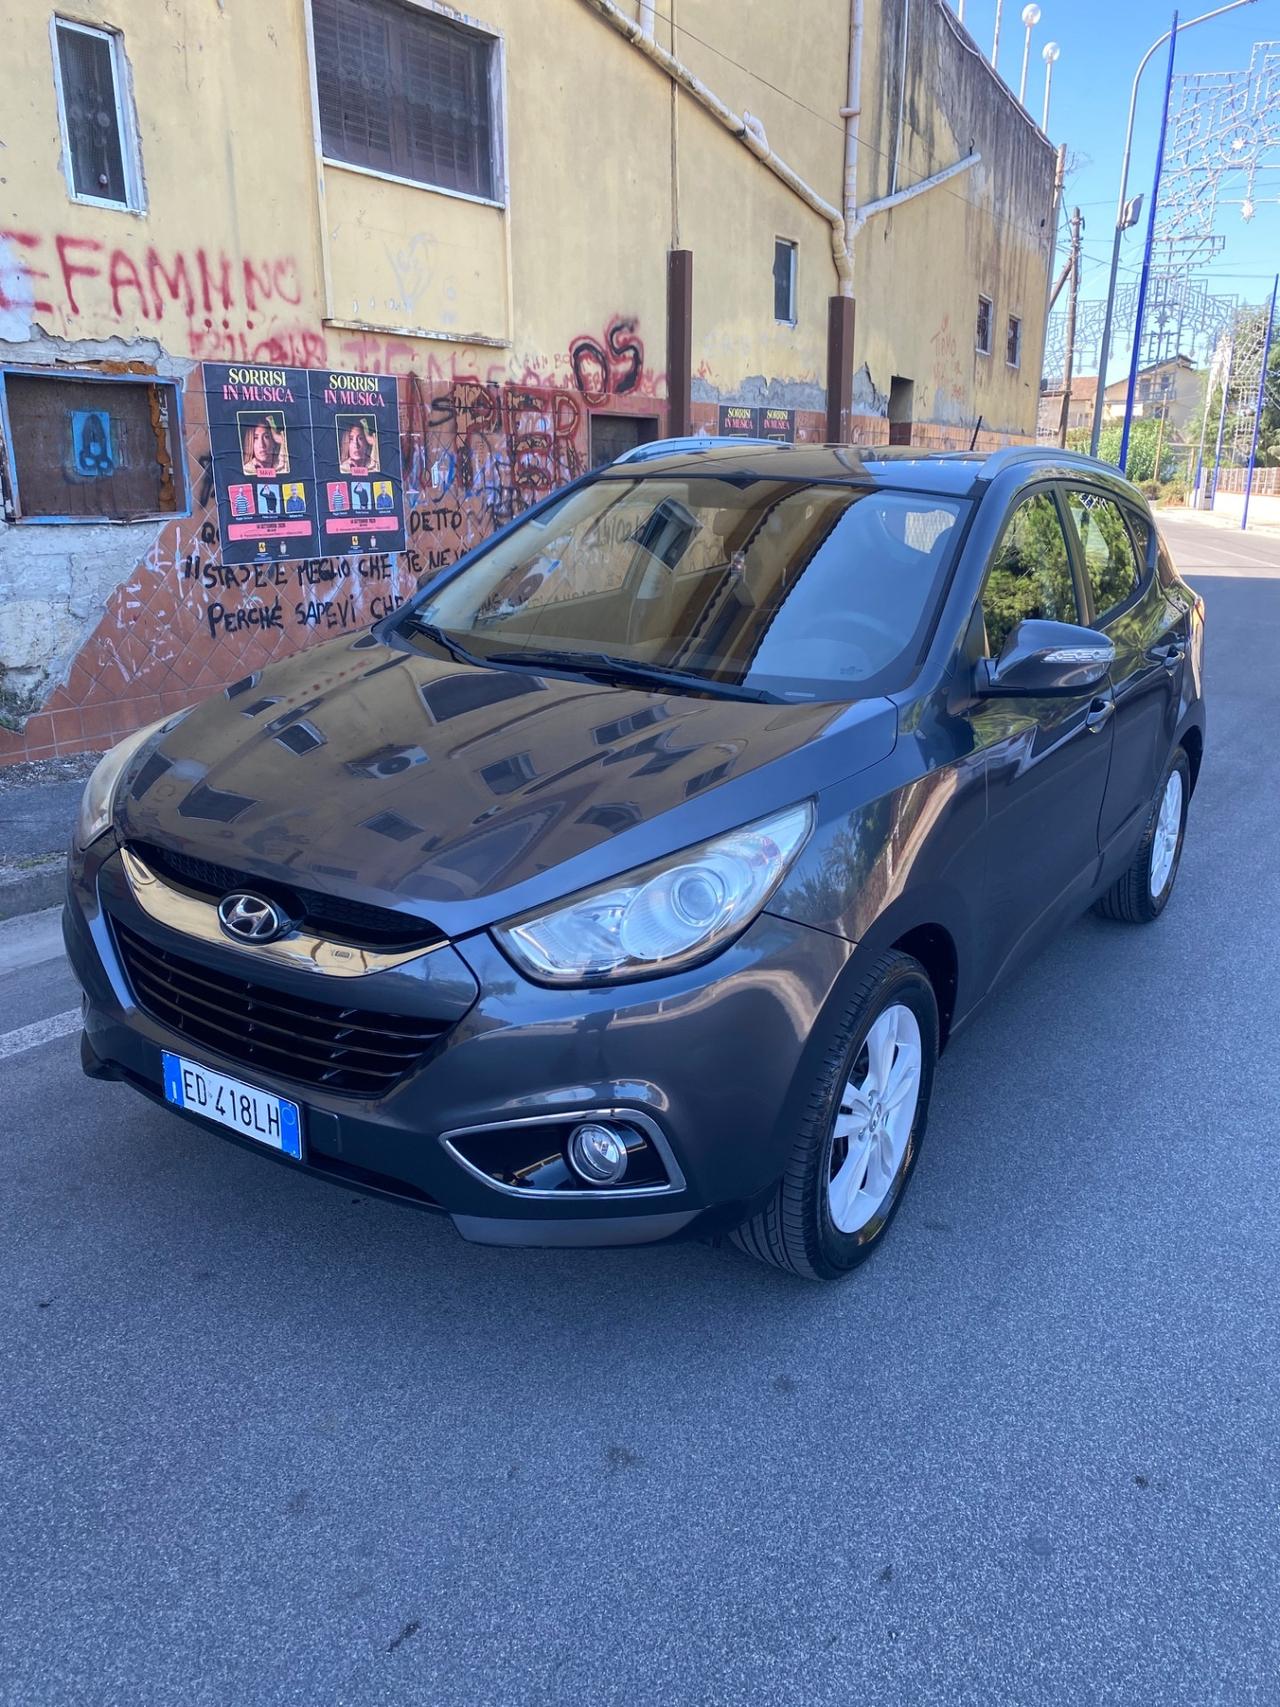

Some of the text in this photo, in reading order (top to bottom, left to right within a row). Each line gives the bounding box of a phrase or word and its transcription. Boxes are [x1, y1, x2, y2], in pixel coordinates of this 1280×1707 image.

[228, 368, 287, 387] SORRISI
[329, 374, 380, 393] SORRISI
[223, 384, 295, 404] IN MUSICA
[324, 389, 386, 408] IN MUSICA
[410, 507, 463, 535] DETTO
[357, 554, 393, 581] CHE
[404, 551, 423, 574] TE
[428, 551, 453, 571] NE
